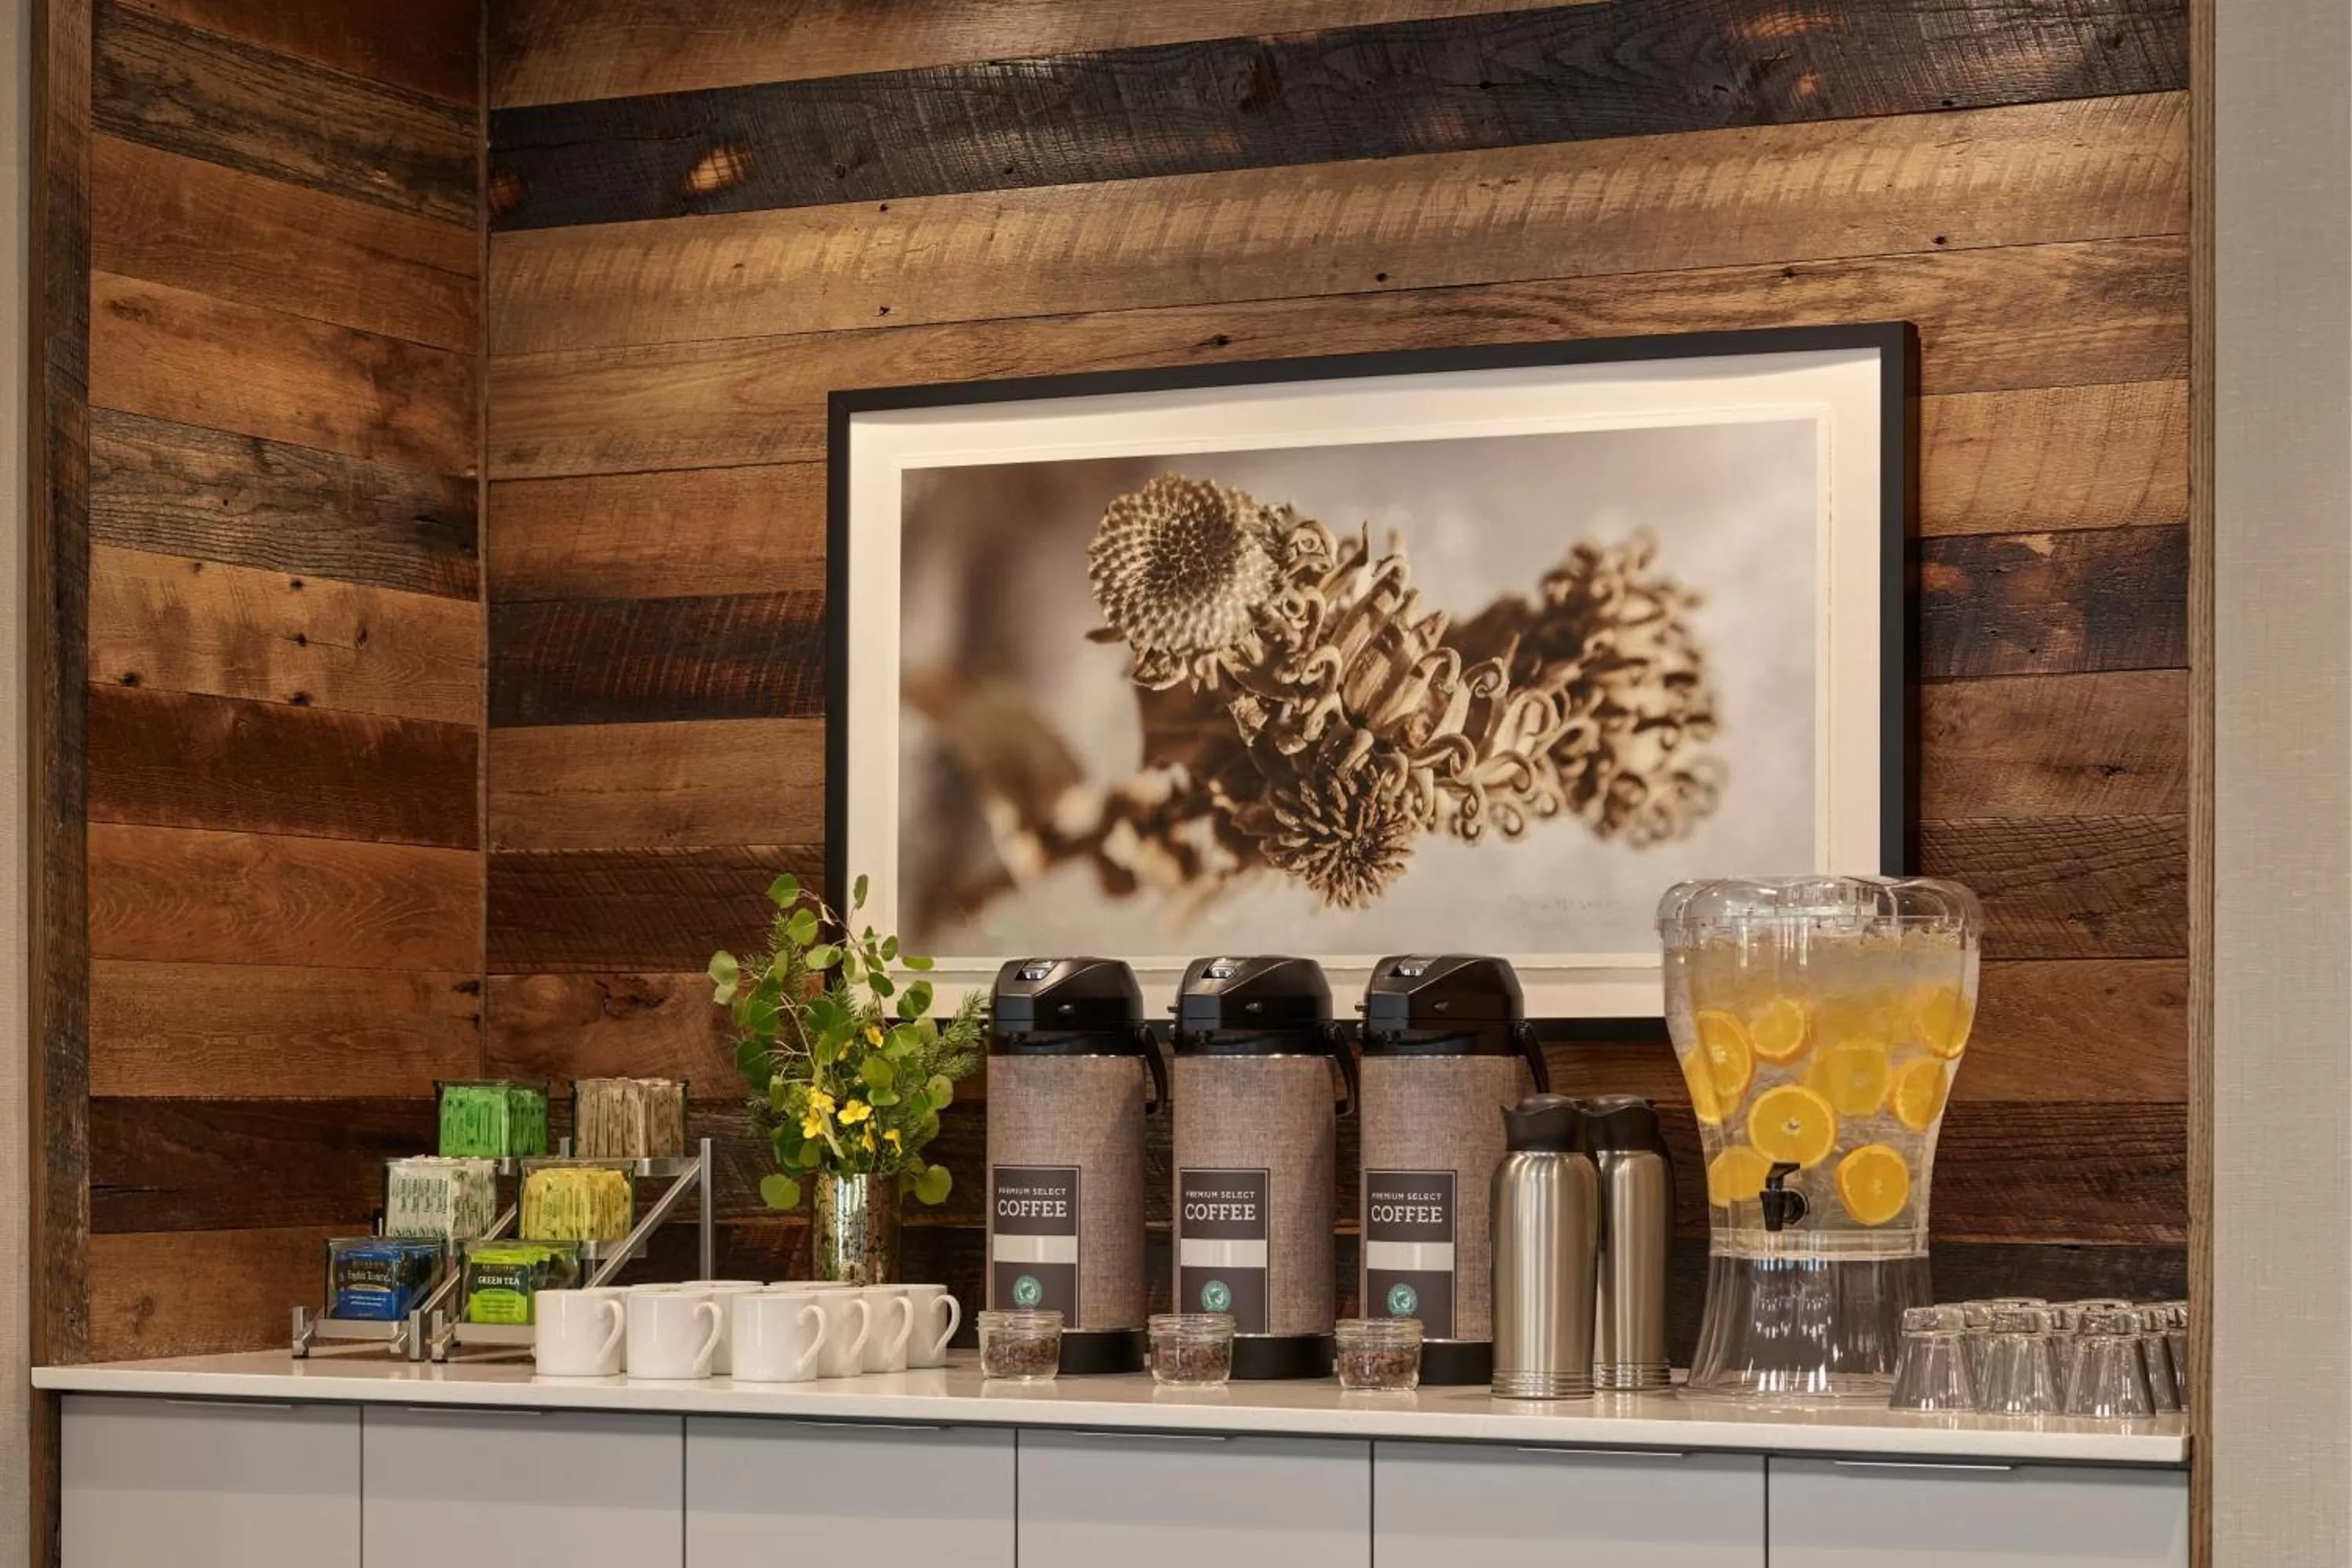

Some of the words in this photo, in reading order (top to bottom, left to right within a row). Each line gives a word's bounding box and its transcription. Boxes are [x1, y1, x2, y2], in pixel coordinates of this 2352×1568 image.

[1032, 1187, 1067, 1196] SELECT
[998, 1200, 1067, 1218] COFFEE
[1185, 1203, 1256, 1221] COFFEE
[1371, 1205, 1443, 1223] COFFEE
[477, 1276, 503, 1285] GREEN
[503, 1276, 520, 1286] TEA
